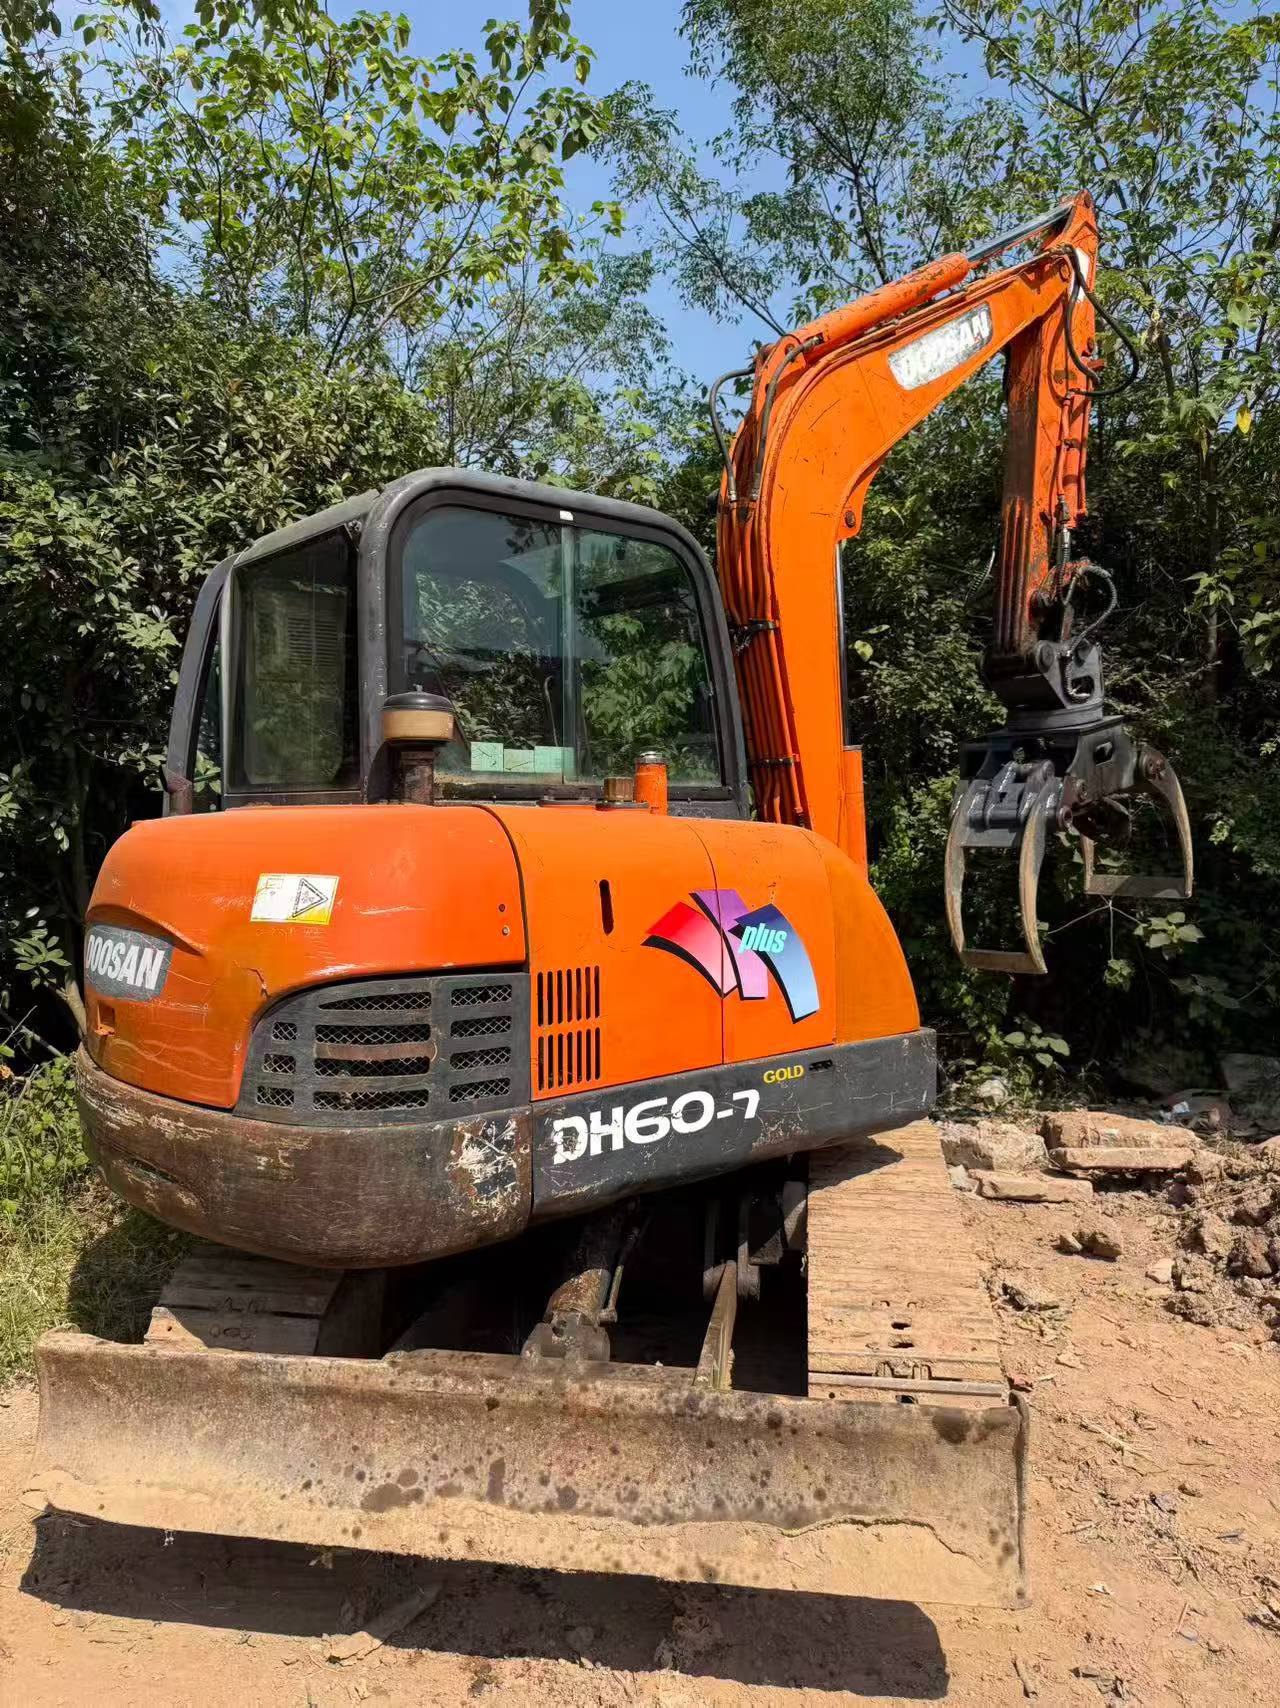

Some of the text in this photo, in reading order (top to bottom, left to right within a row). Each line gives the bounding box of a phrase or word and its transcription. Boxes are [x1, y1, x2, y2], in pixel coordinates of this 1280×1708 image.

[738, 923, 788, 954] plus
[763, 1064, 804, 1084] GOLD
[553, 1089, 760, 1165] DH60-7
